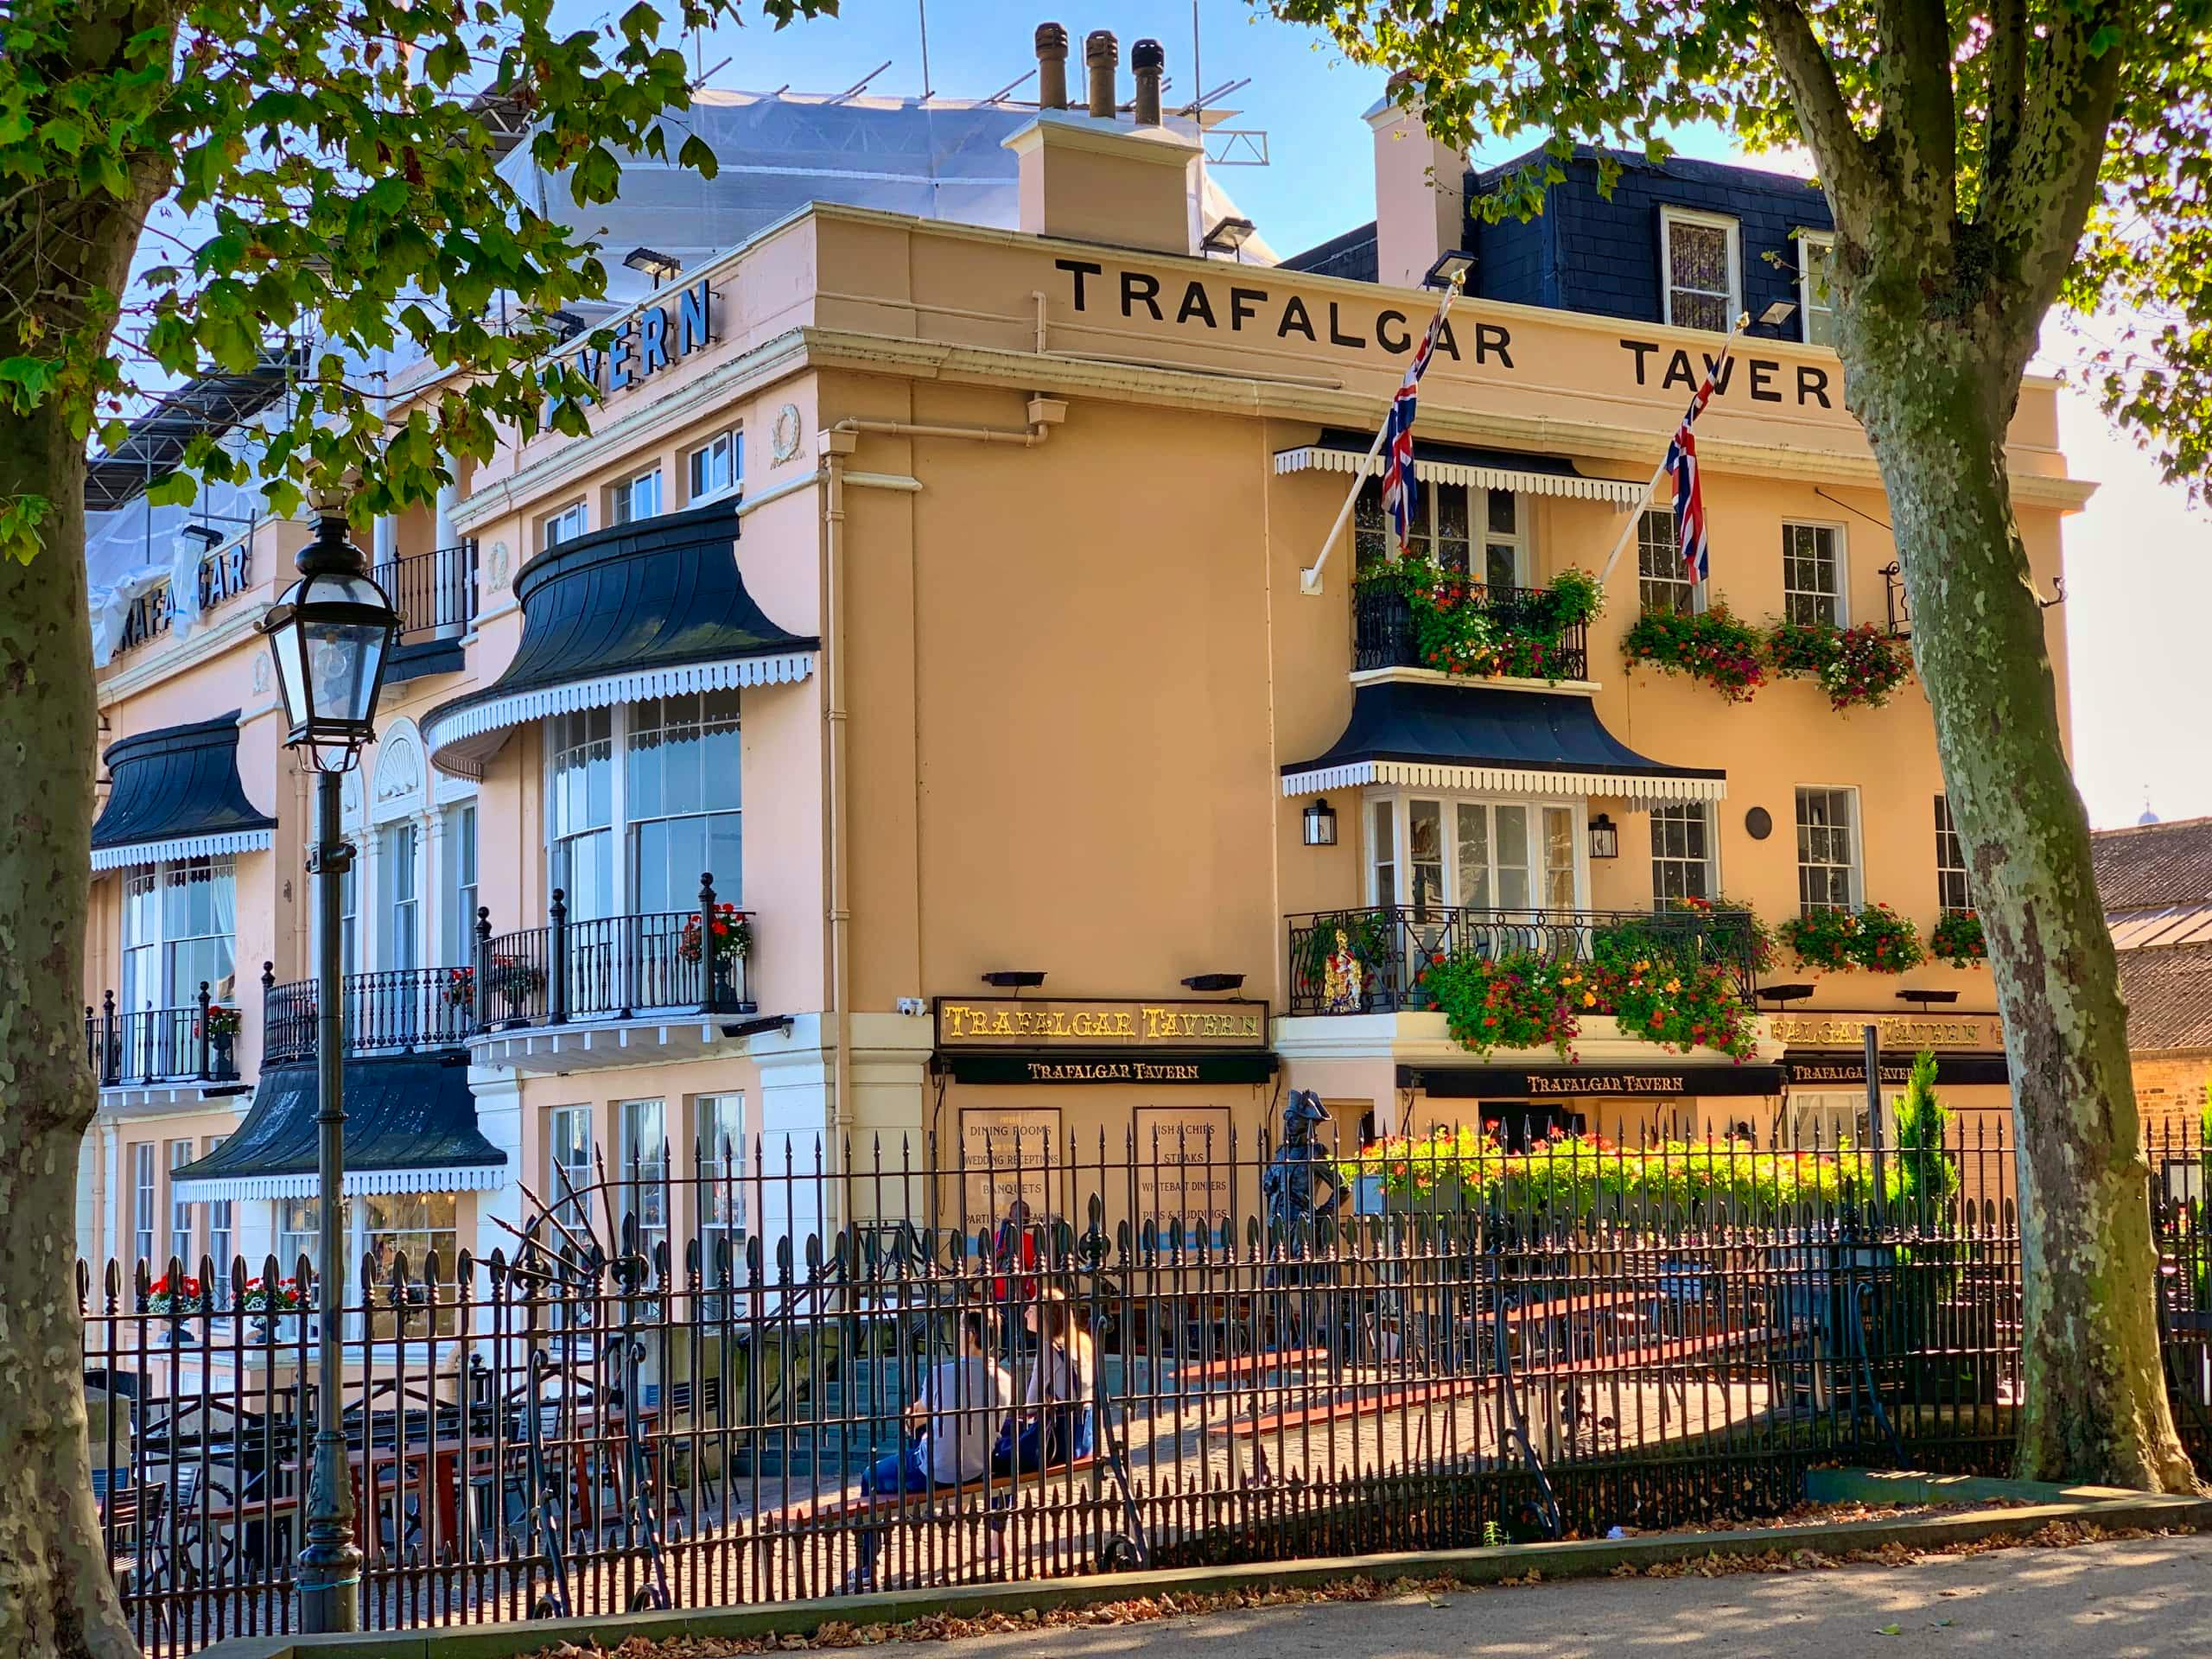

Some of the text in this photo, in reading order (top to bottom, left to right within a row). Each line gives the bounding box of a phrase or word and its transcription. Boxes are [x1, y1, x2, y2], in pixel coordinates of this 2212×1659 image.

[1055, 258, 1850, 410] TRAFALGAR TAVER
[944, 1006, 1260, 1038] TRAFALGAR TAVERN
[1027, 1063, 1200, 1080] TRAFALGAR TAVERN
[1793, 1065, 1866, 1080] TRAFALGA
[1527, 1075, 1684, 1093] TRAFALGAR TAVERN
[969, 1125, 1009, 1137] DINING
[965, 1154, 1004, 1166] WEDDNG
[1141, 1180, 1227, 1192] WHTEBAT DINERS
